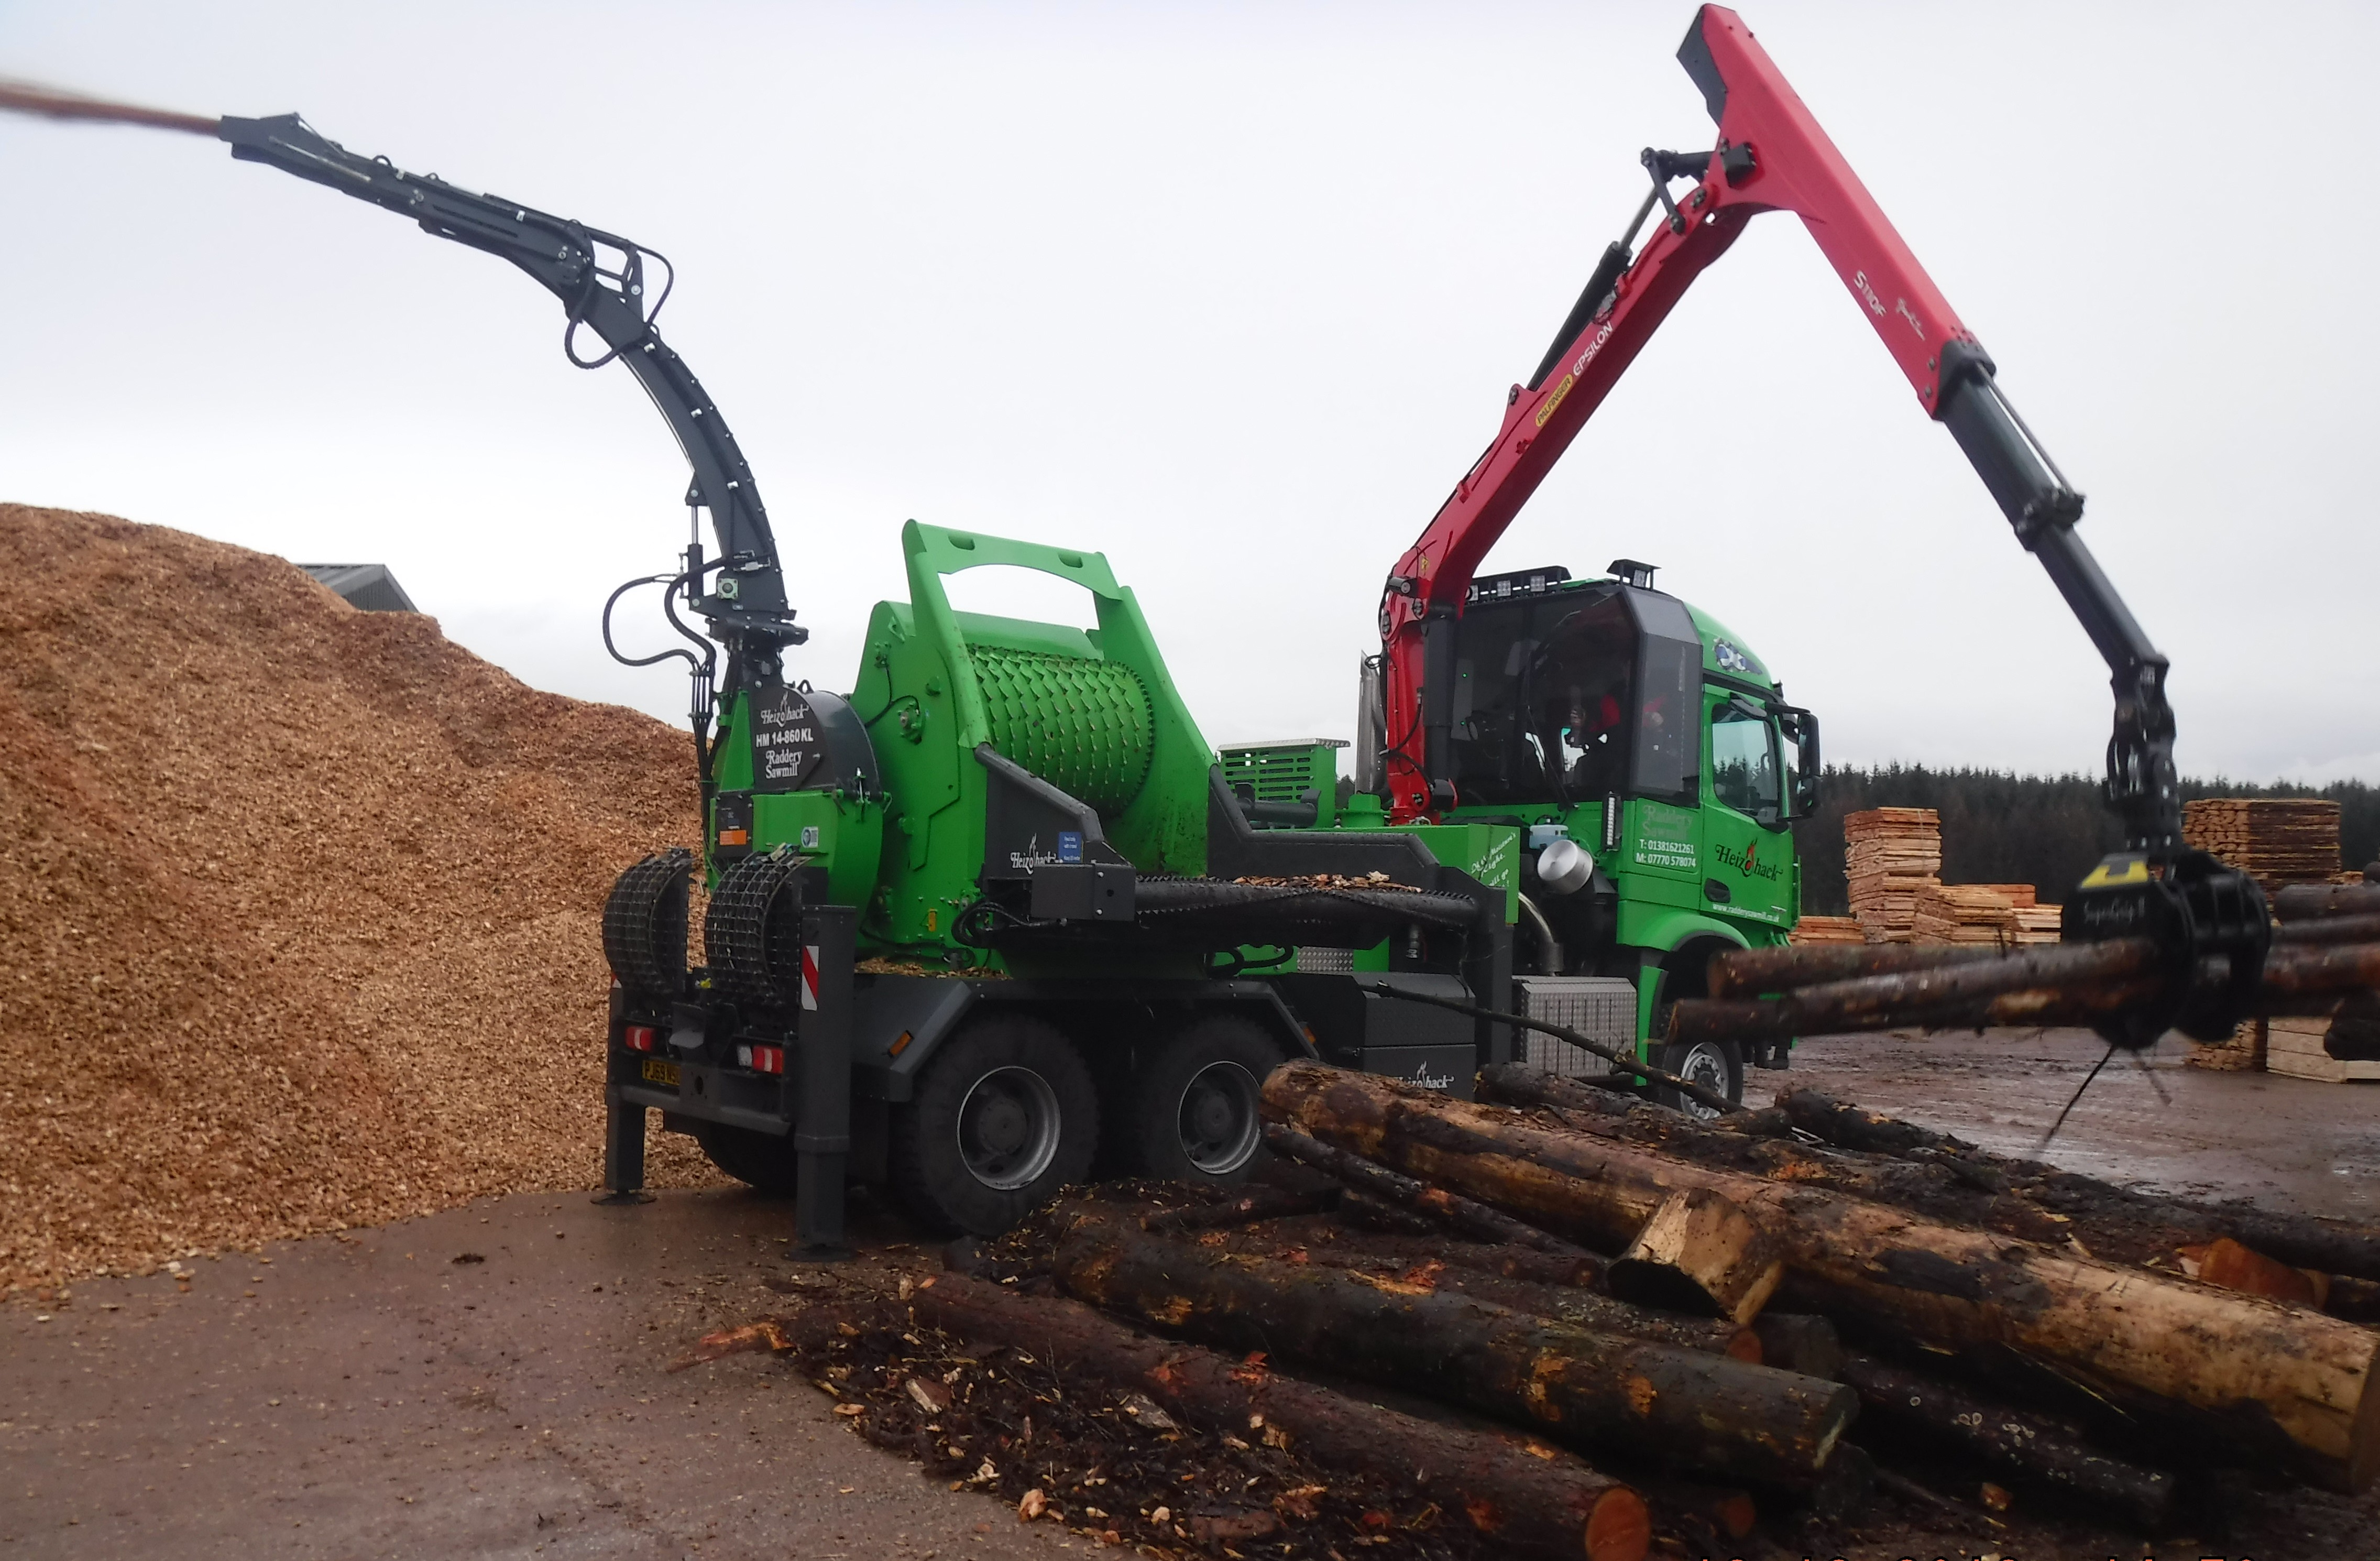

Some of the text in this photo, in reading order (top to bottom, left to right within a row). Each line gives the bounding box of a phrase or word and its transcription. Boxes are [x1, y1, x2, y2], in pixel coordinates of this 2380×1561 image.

[1537, 320, 1613, 425] PALFINGER EPSILON
[760, 703, 809, 727] Heizohack
[756, 728, 814, 748] HM 14-860 KL
[765, 748, 802, 765] Raddery
[765, 763, 798, 779] Sawmill
[1639, 838, 1694, 855] T: 01381621261
[1636, 853, 1696, 868] M: 07770 578074
[1716, 843, 1783, 881] Heizohack
